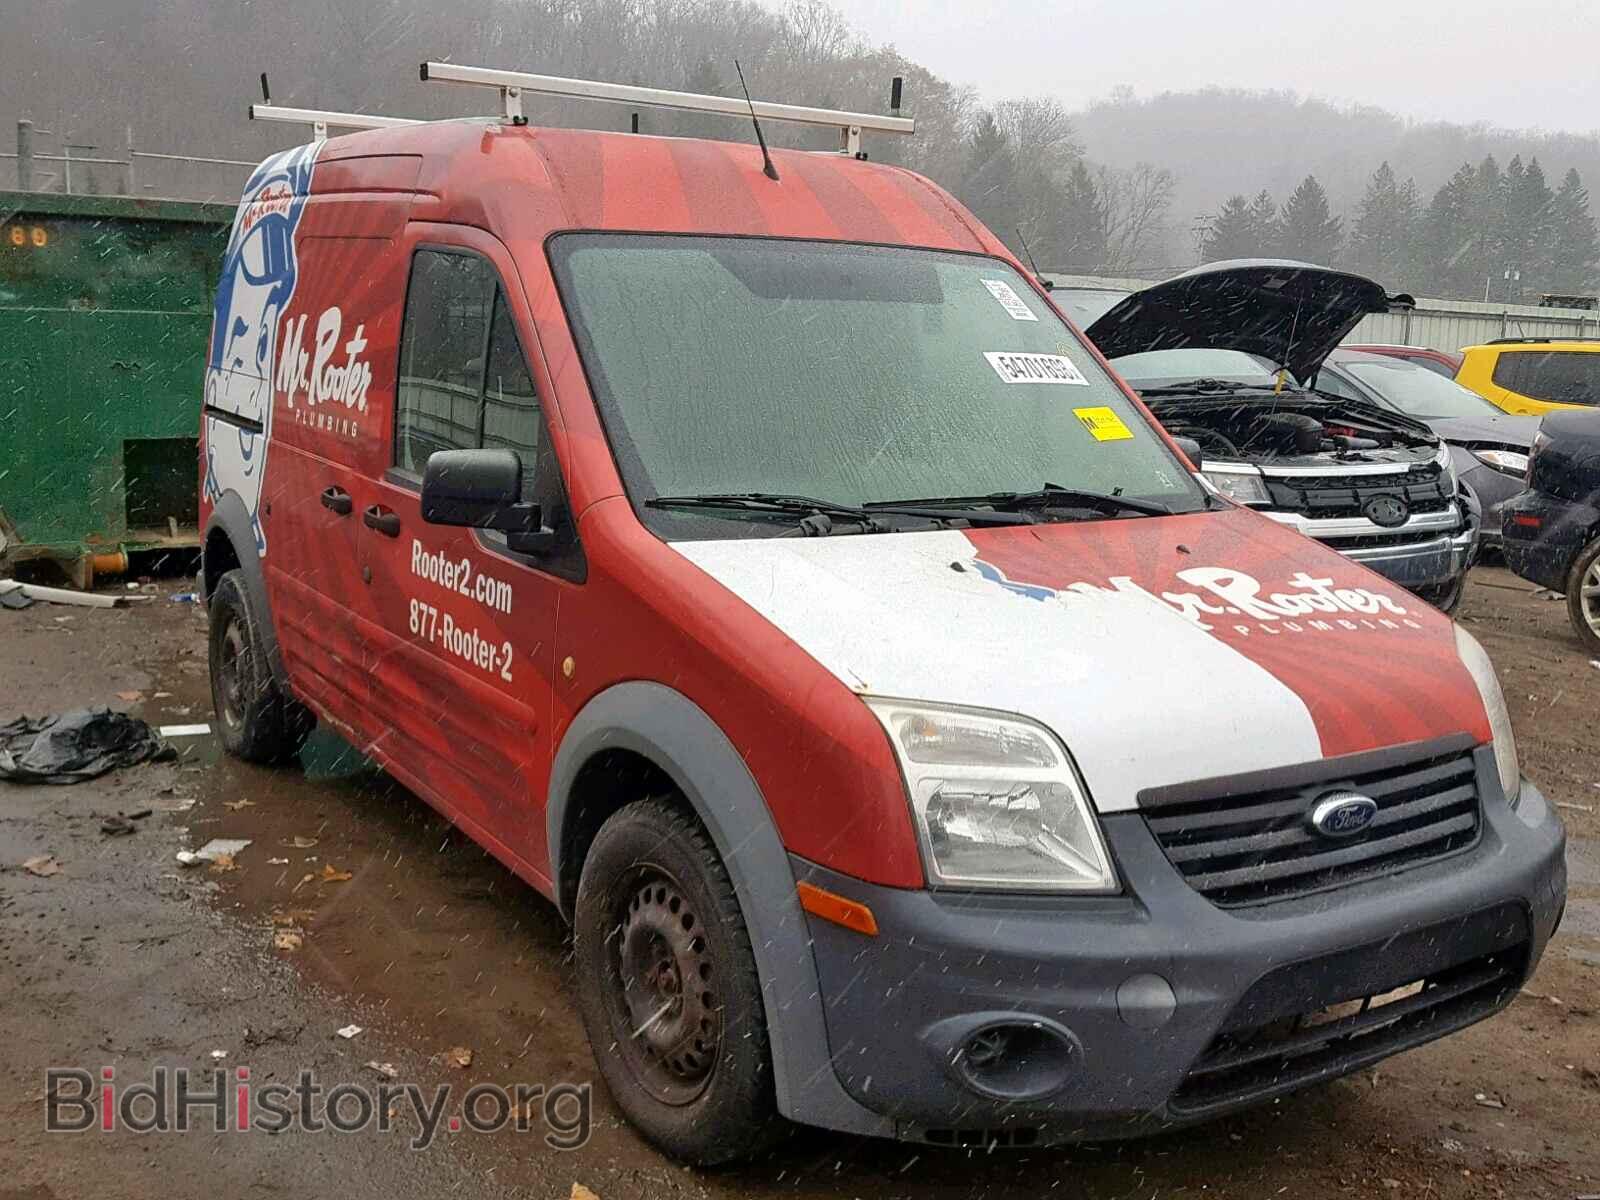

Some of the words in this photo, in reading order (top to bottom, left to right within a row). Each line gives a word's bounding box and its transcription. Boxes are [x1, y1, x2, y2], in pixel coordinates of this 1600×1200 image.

[277, 314, 309, 408] Mr.
[308, 306, 372, 412] Rooter
[295, 408, 358, 437] PLUMBING
[411, 538, 512, 614] Rooter2.com
[1175, 566, 1407, 620] Rooter
[409, 598, 512, 682] 877-Rooter-2
[1233, 619, 1421, 636] PLUMBING
